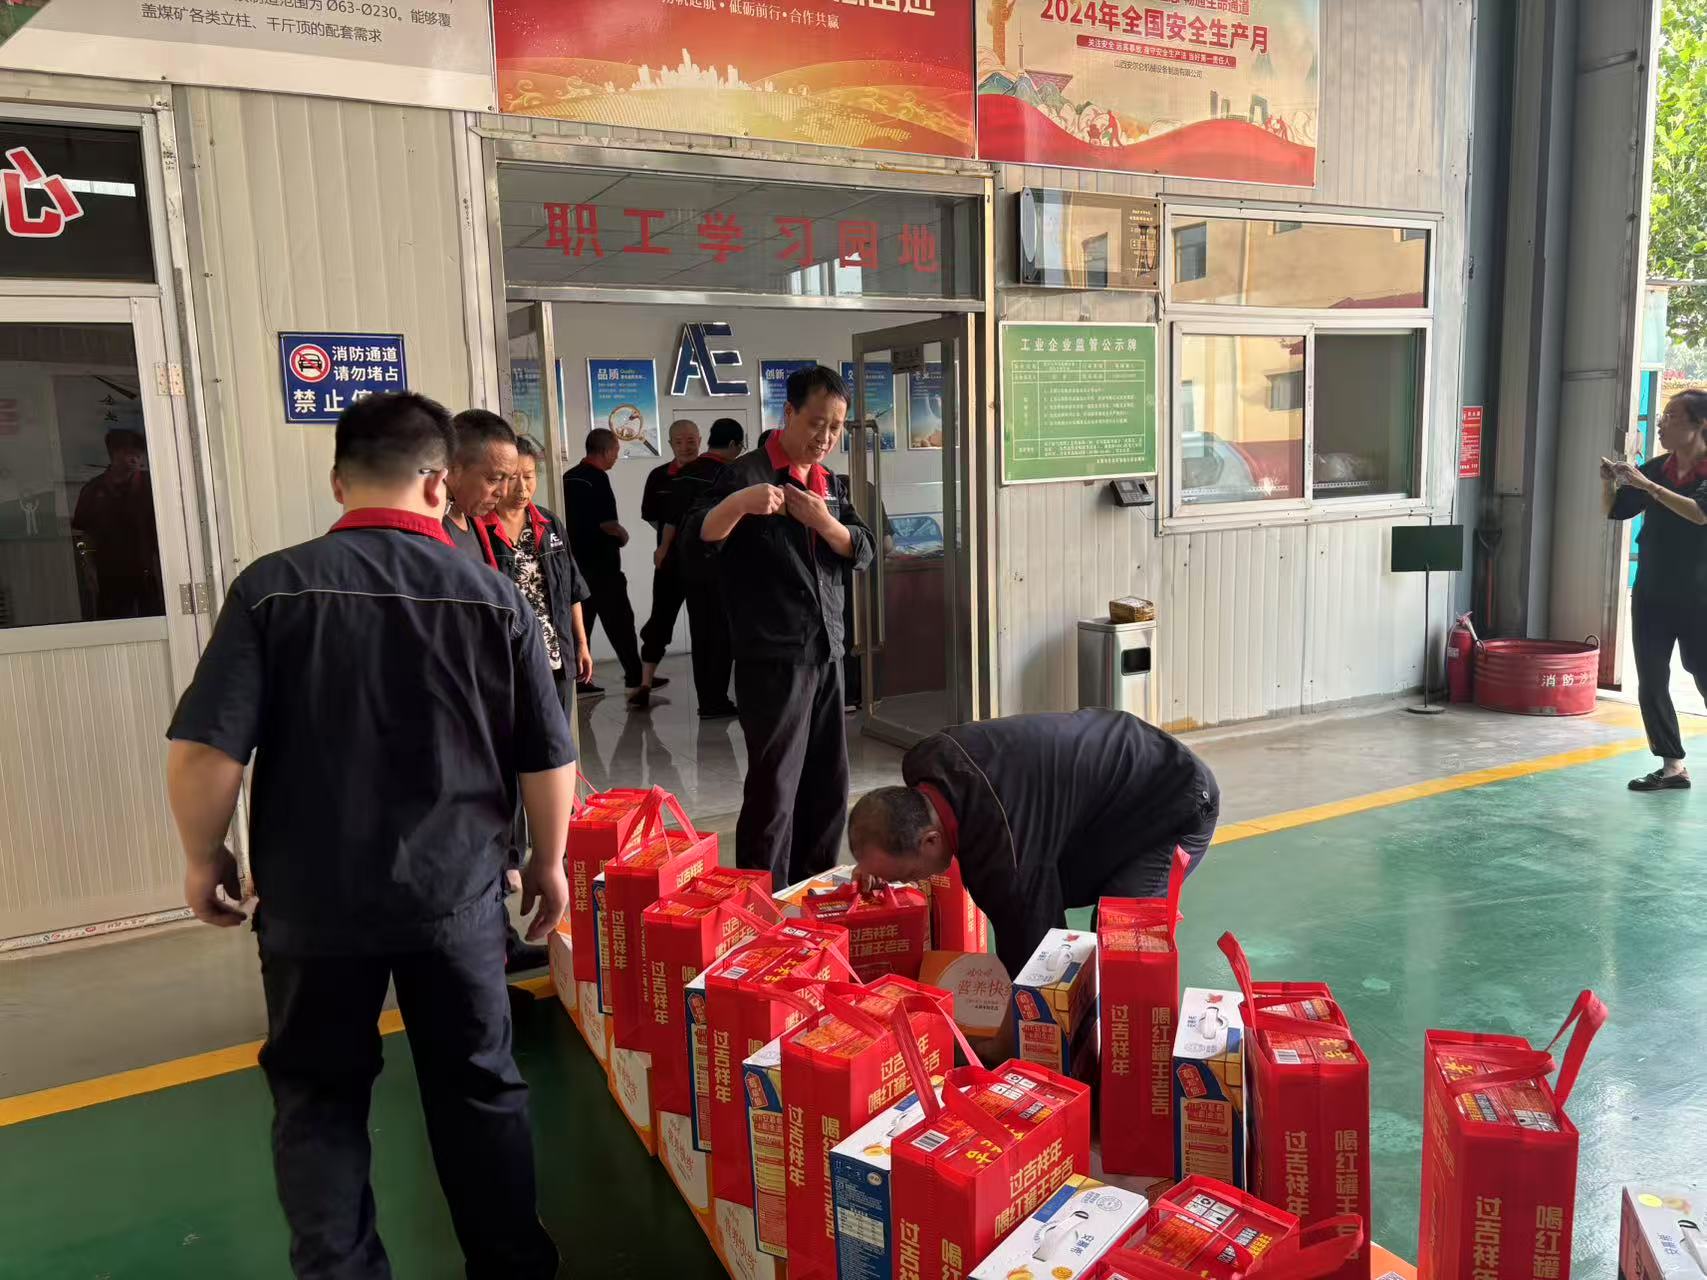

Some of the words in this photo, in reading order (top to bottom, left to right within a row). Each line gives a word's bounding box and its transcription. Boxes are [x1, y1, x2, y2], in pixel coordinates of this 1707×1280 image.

[1040, 0, 1269, 54] 2024年全国安全生产月
[0, 147, 84, 237] 心
[543, 202, 938, 273] 职工学习园地
[331, 345, 398, 362] 消防通道
[333, 366, 399, 382] 请勿堵占
[671, 322, 750, 396] AE
[1020, 338, 1137, 352] 工业企业监管公示牌
[652, 961, 669, 1024] 过吉祥年
[714, 1030, 731, 1103] 过吉祥年
[1111, 1004, 1129, 1076] 过吉祥年
[1151, 1007, 1170, 1115] 喝红罐王老吉
[788, 1104, 805, 1188] 过吉祥年
[1010, 1136, 1063, 1199] 过吉祥年
[1285, 1130, 1309, 1217] 过吉祥年
[995, 1153, 1074, 1240] 喝红罐王老吉
